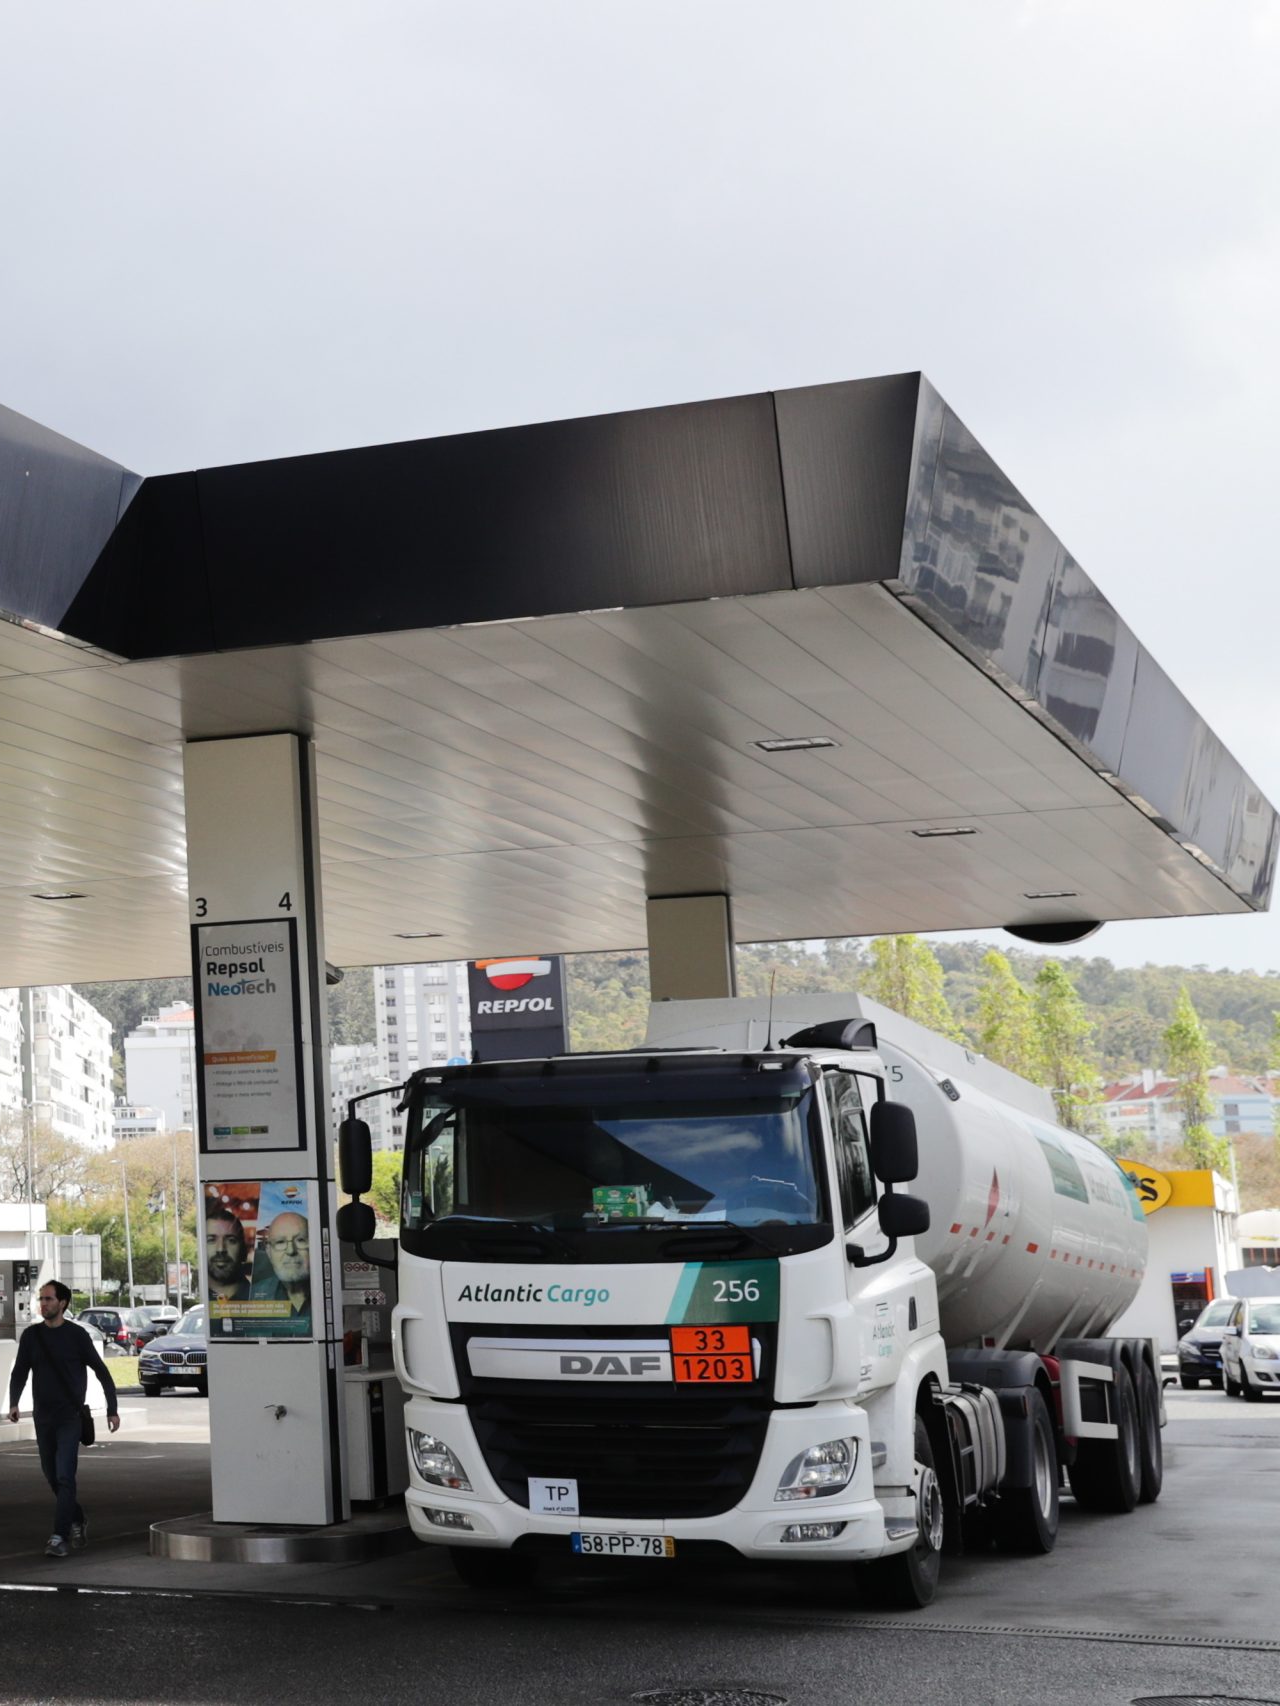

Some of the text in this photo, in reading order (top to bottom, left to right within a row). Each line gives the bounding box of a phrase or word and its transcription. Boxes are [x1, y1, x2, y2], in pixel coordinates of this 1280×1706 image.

[195, 897, 207, 917] 3
[278, 892, 292, 911] 4
[205, 941, 284, 957] Combustíveis
[206, 957, 265, 978] Repsol
[207, 978, 276, 997] NeoTech
[477, 997, 554, 1014] REPSOL
[458, 1283, 610, 1306] Atlantic Cargo
[712, 1279, 760, 1302] 256
[694, 1329, 725, 1351] 33
[560, 1356, 661, 1375] DAF
[683, 1358, 745, 1380] 1203
[545, 1485, 569, 1501] TP
